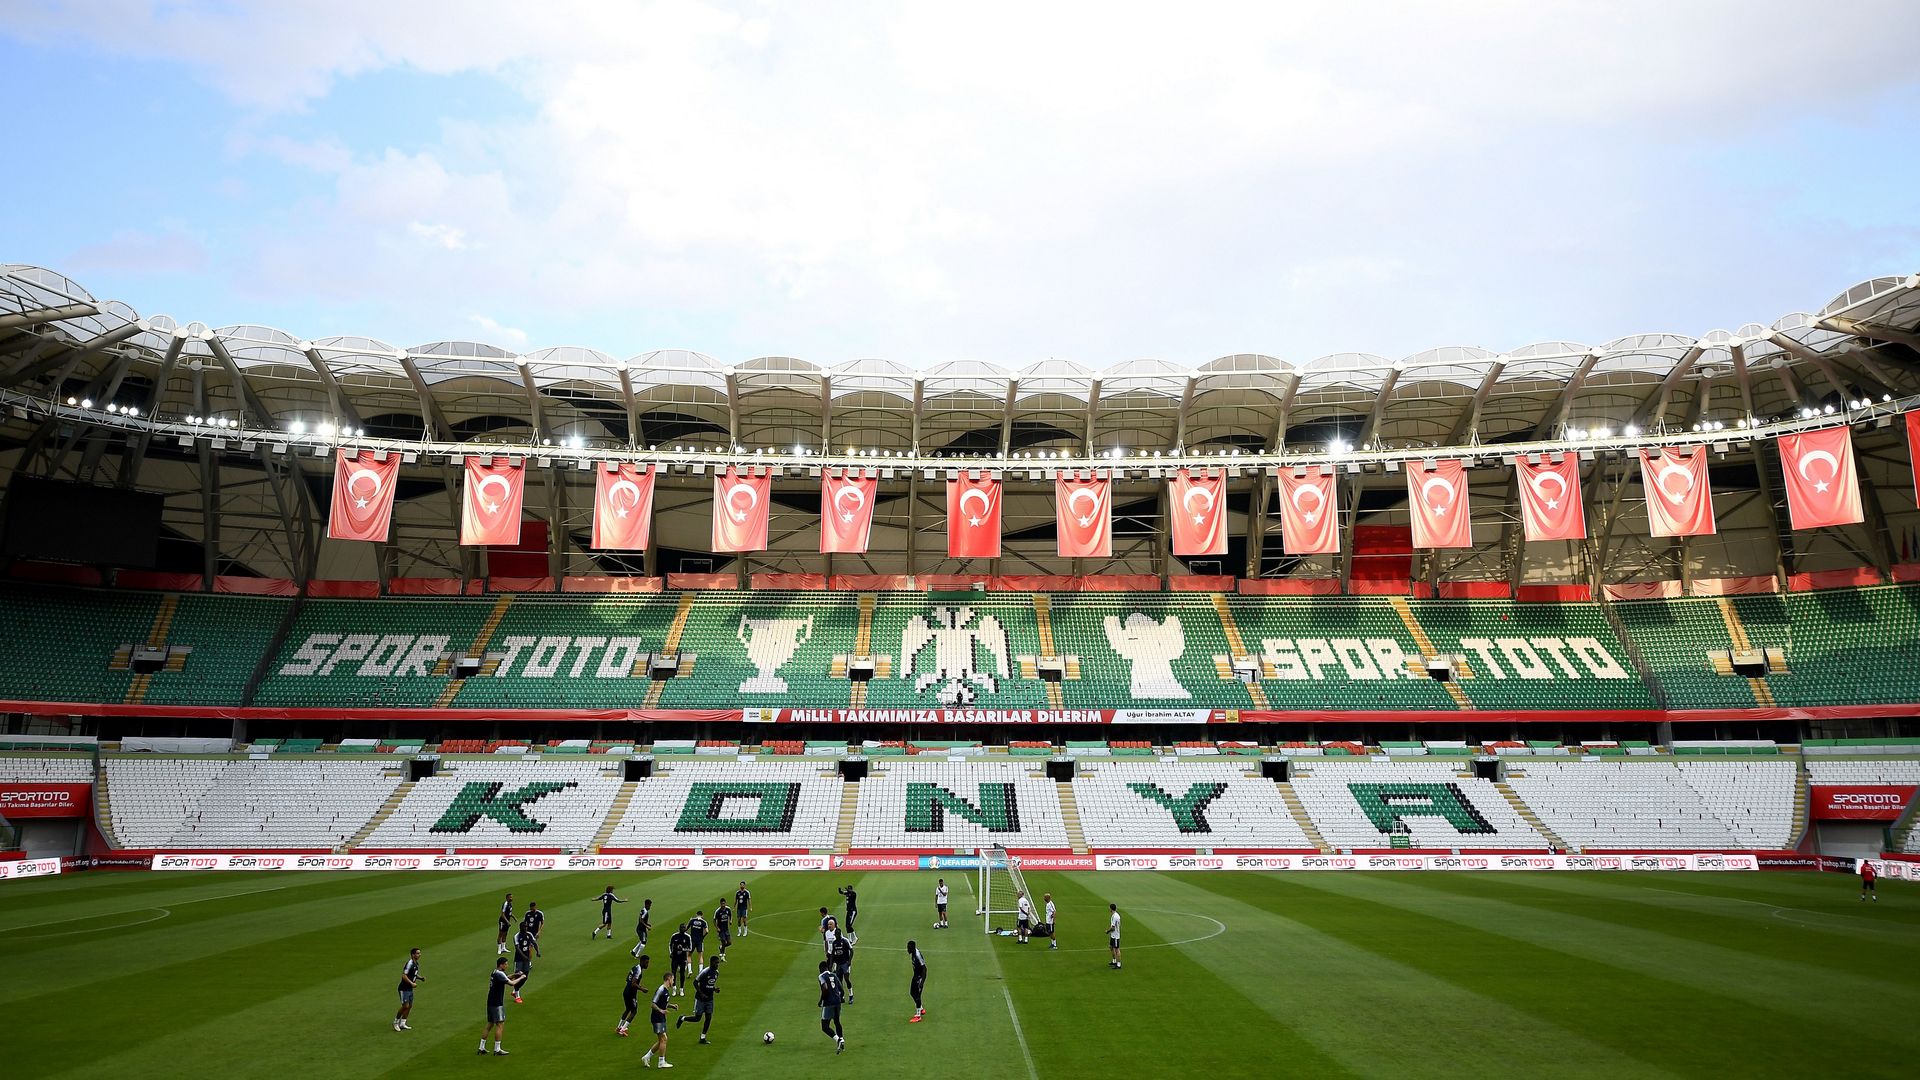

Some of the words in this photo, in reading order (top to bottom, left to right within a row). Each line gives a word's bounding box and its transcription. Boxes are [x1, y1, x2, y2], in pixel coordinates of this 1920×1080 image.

[279, 634, 450, 677] SPOR
[495, 636, 642, 678] TOTO
[1261, 638, 1424, 680] SPOR
[1459, 637, 1630, 679] TOTO
[838, 709, 939, 722] TAKIMIMIZA
[846, 859, 880, 867] EUROPEAN
[881, 859, 916, 867] QUALIFIERS
[1023, 859, 1057, 867] EUROPEAN
[1058, 859, 1093, 867] QUALIFIERS
